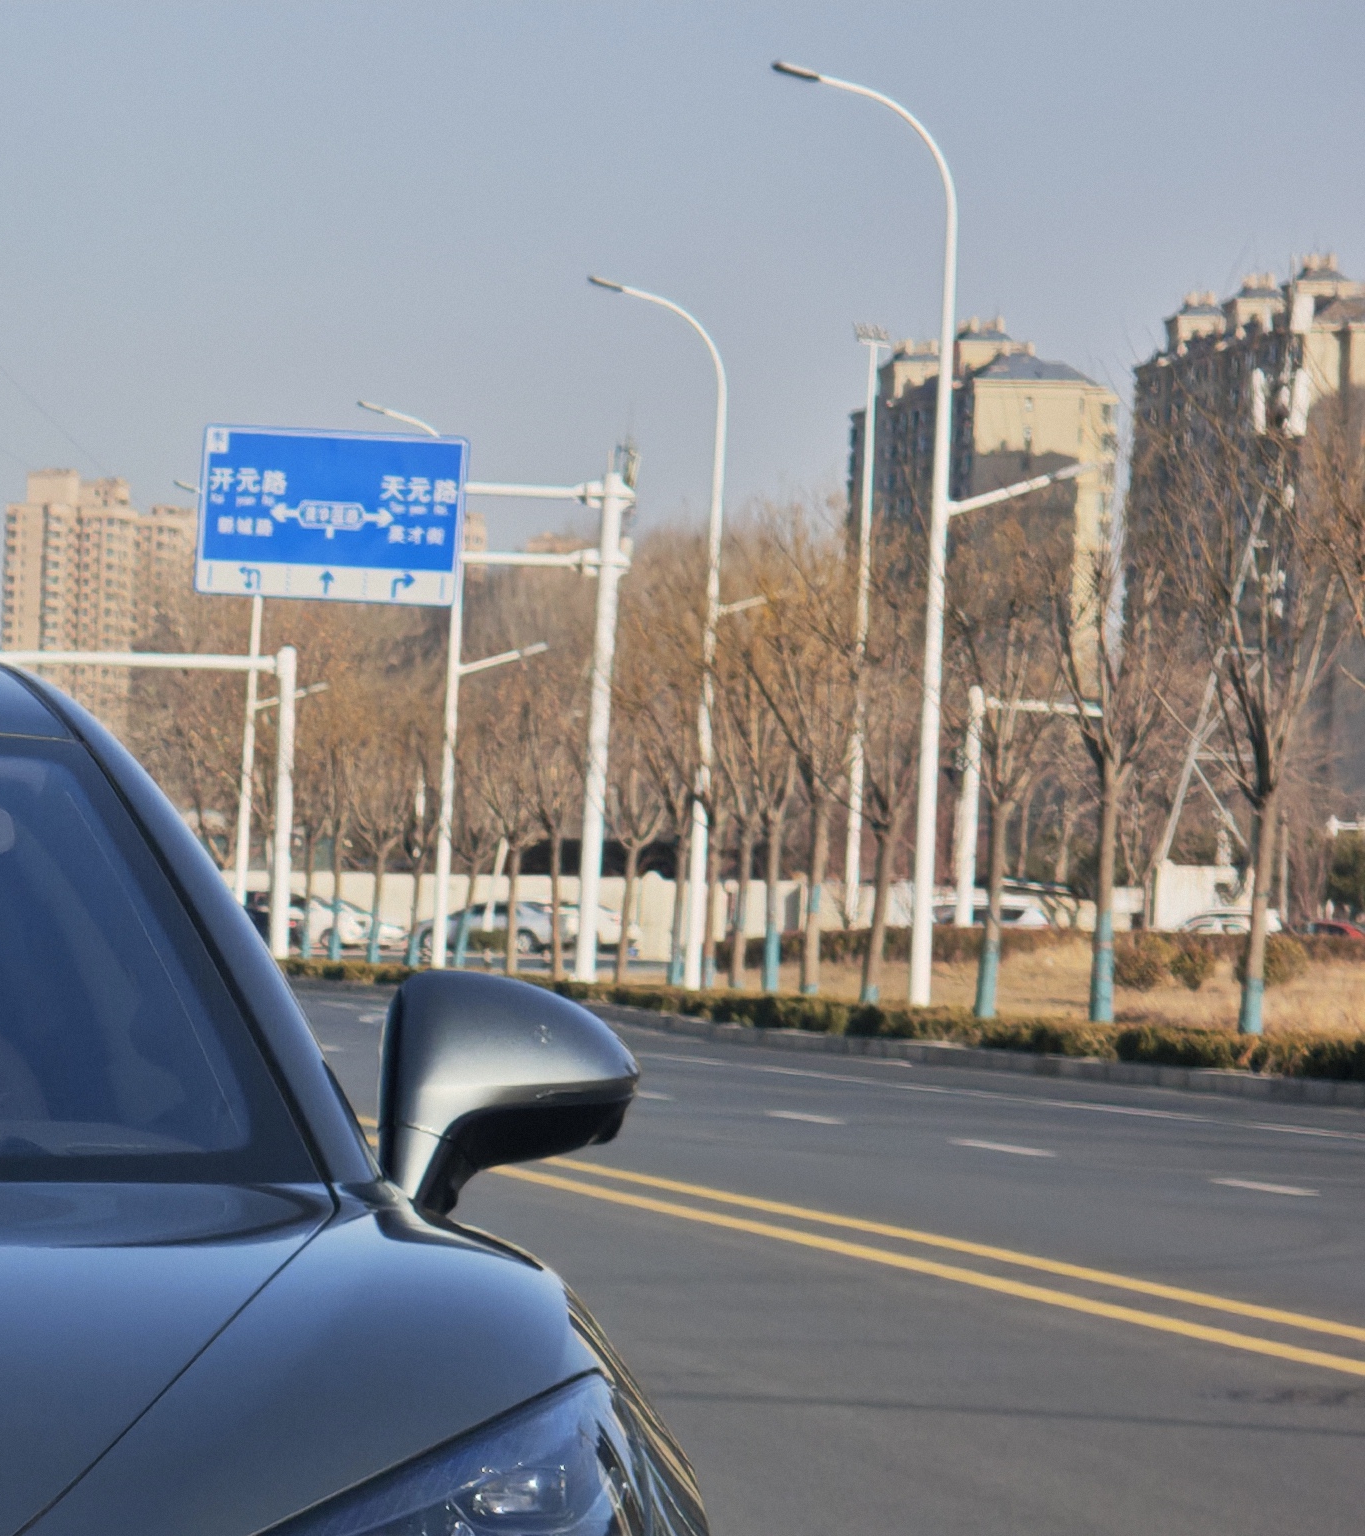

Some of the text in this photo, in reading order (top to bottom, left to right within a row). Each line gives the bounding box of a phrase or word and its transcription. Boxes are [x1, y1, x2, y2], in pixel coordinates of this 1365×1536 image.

[210, 468, 287, 494] 开元路
[381, 476, 457, 503] 天元路
